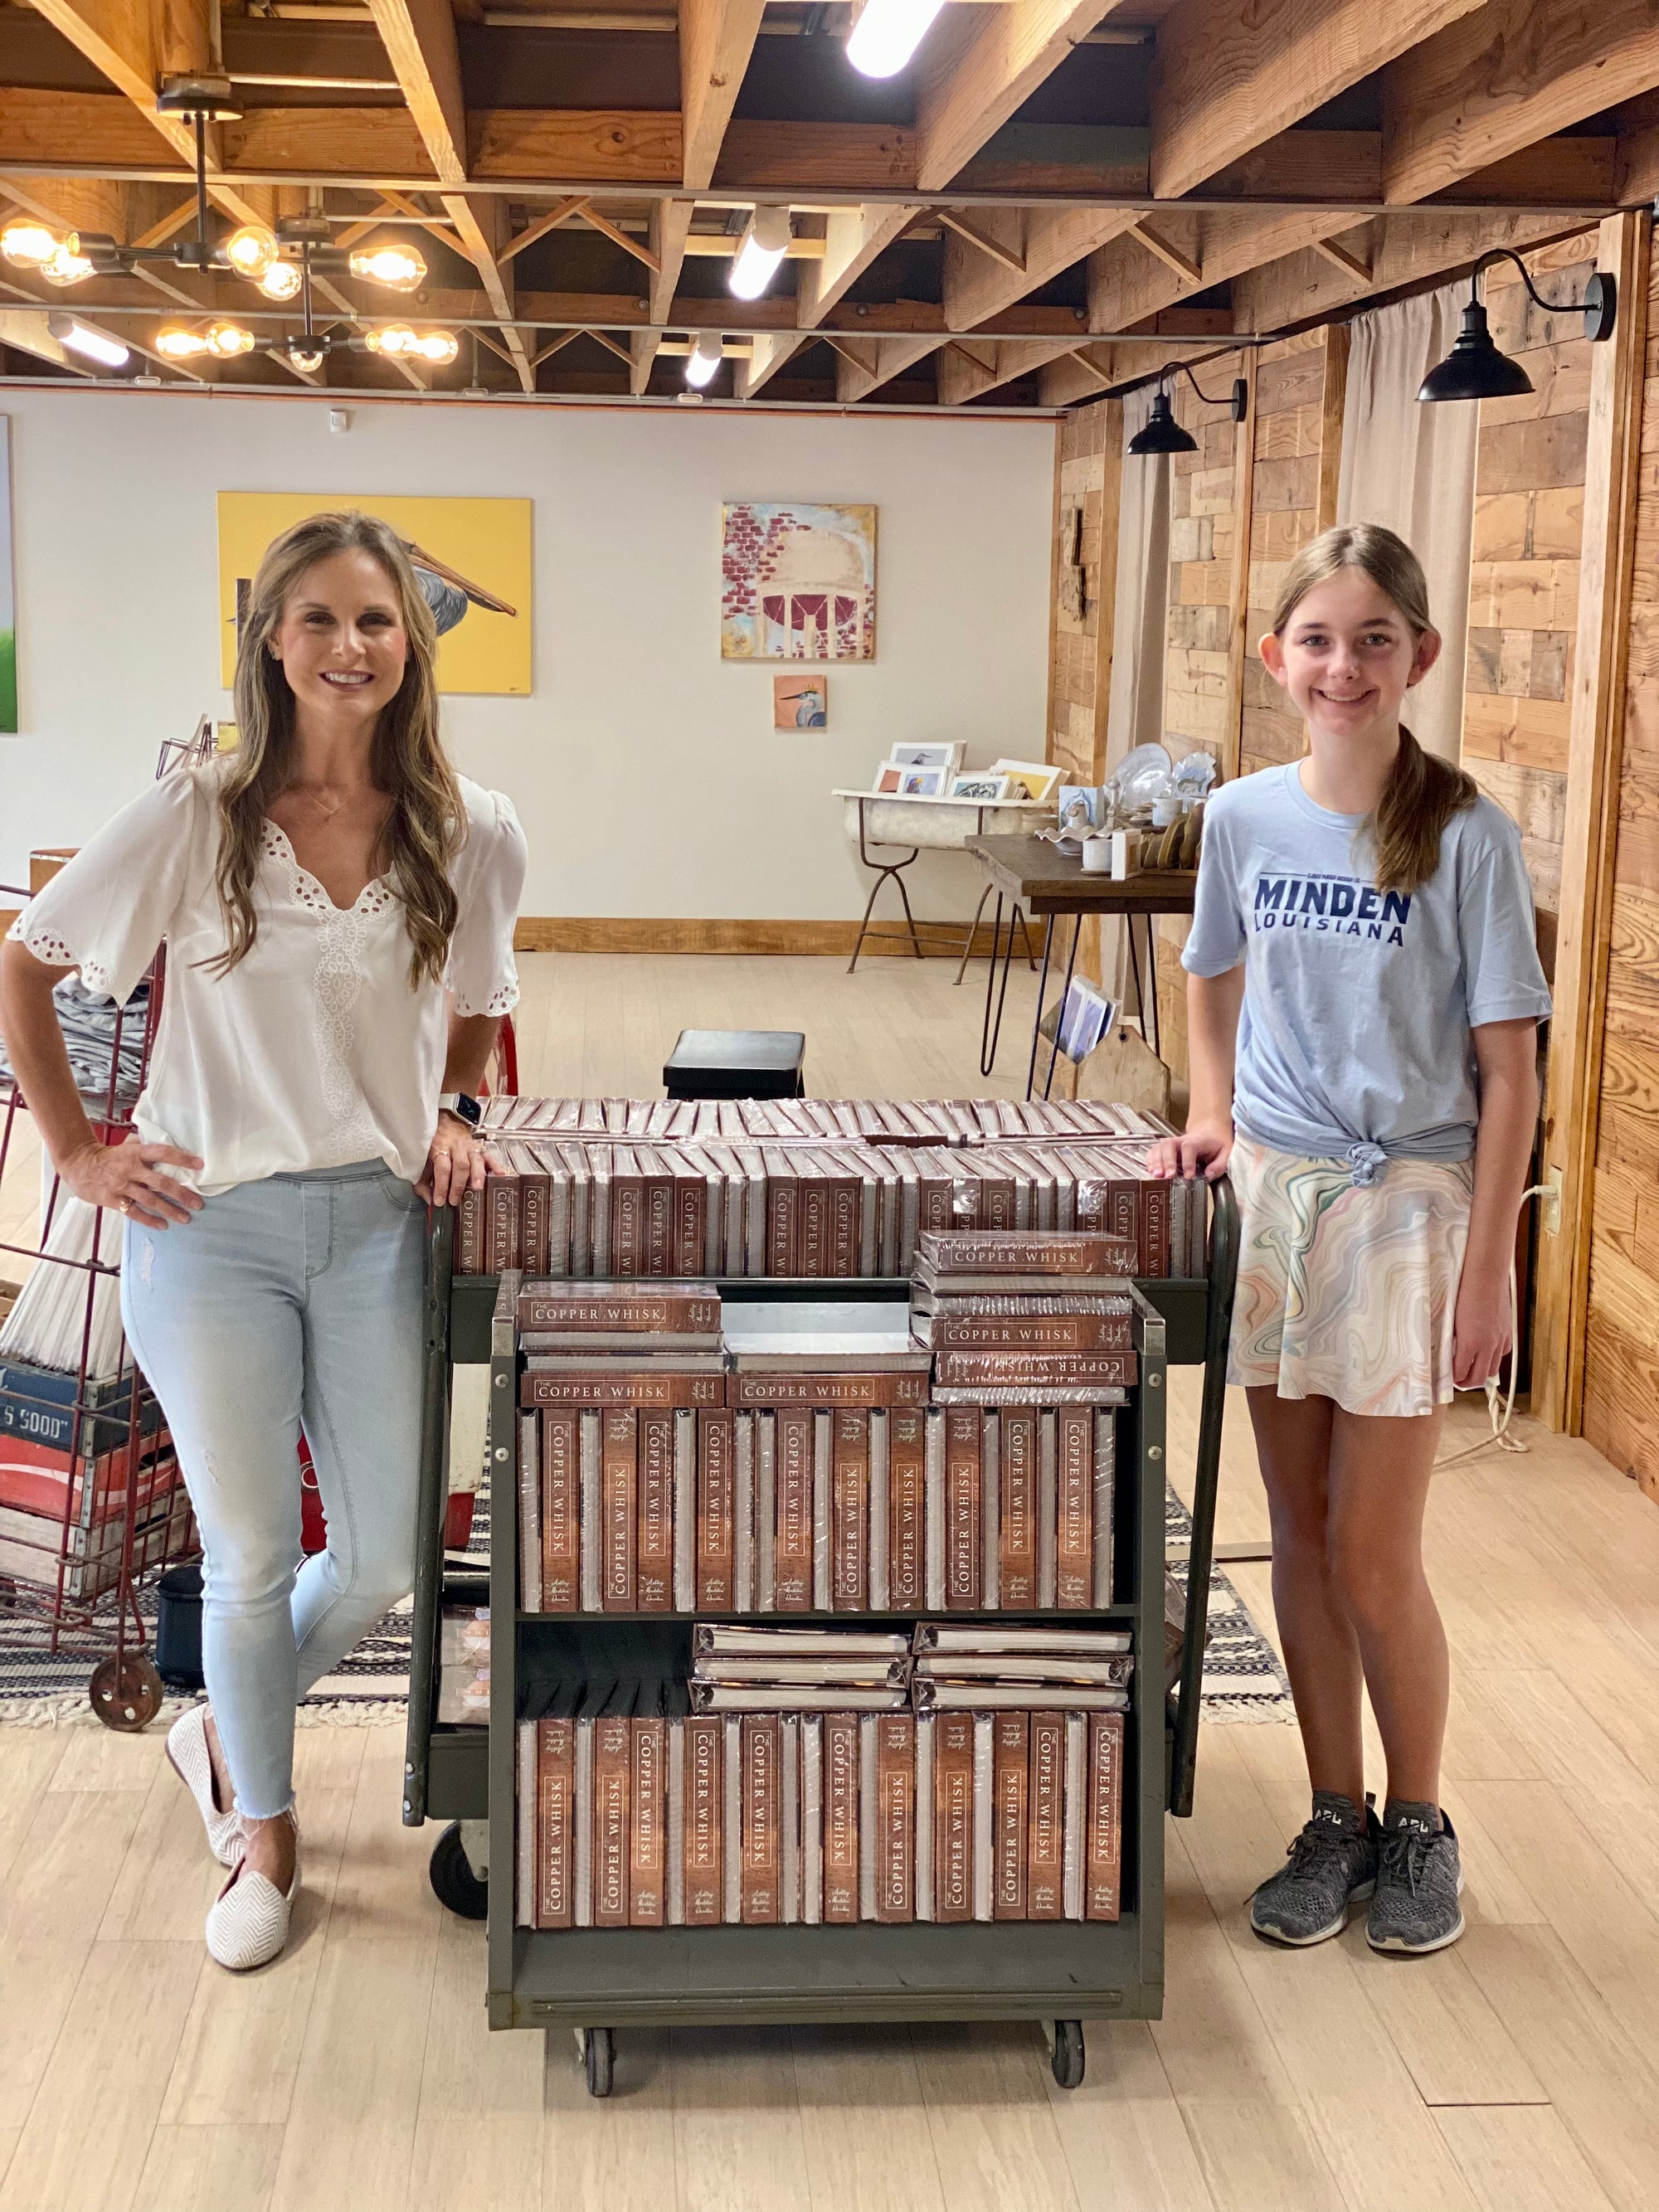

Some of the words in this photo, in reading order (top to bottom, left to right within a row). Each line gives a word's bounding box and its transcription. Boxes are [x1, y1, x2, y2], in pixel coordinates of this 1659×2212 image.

[1254, 879, 1411, 925] MINDEN
[1255, 913, 1404, 946] LOUISIANA
[464, 1190, 474, 1247] COPPER
[496, 1192, 507, 1249] COPPER
[527, 1189, 537, 1247] COPPER
[622, 1192, 632, 1248] COPPER
[653, 1190, 663, 1247] COPPER
[684, 1192, 694, 1249] COPPER
[776, 1193, 787, 1250] COPPER
[808, 1194, 818, 1251] COPPER
[838, 1193, 848, 1250] COPPER
[932, 1194, 941, 1237] COPP
[993, 1194, 1003, 1231] COPP
[1150, 1195, 1159, 1251] COPPER
[955, 1252, 1016, 1262] COPPER
[1026, 1252, 1078, 1262] WHISK
[535, 1309, 597, 1319] COPPER
[607, 1309, 661, 1319] WHISK
[949, 1330, 1010, 1339] COPPER
[1019, 1330, 1072, 1339] WHISK
[539, 1387, 601, 1397] COPPER
[611, 1387, 664, 1397] WHISK
[745, 1386, 806, 1396] COPPER
[816, 1386, 869, 1396] WHISK
[1060, 1361, 1119, 1371] COPPER
[553, 1426, 564, 1488] COPPER
[649, 1426, 659, 1488] COPPER
[709, 1427, 720, 1488] COPPER
[788, 1427, 799, 1488] COPPER
[1013, 1424, 1023, 1485] COPPER
[1069, 1425, 1079, 1486] COPPER
[615, 1468, 625, 1522] WHISK
[847, 1468, 857, 1521] WHISK
[903, 1469, 913, 1522] WHISK
[959, 1468, 969, 1520] WHISK
[1013, 1495, 1023, 1548] WHISK
[553, 1498, 564, 1551] WHISK
[649, 1498, 659, 1551] WHISK
[709, 1498, 719, 1551] WHISK
[788, 1498, 798, 1551] WHISK
[1069, 1496, 1079, 1548] WHISK
[615, 1532, 625, 1594] COPPER
[847, 1532, 857, 1593] COPPER
[903, 1532, 913, 1593] COPPER
[959, 1531, 969, 1592] COPPER
[641, 1735, 651, 1799] COPPER
[698, 1735, 708, 1797] COPPER
[755, 1735, 765, 1797] COPPER
[834, 1733, 844, 1796] COPPER
[1040, 1733, 1051, 1795] COPPER
[1099, 1732, 1111, 1794] COPPER
[551, 1782, 562, 1836] WHISK
[609, 1781, 620, 1835] WHISK
[893, 1777, 902, 1831] WHISK
[953, 1777, 963, 1831] WHISK
[1007, 1775, 1017, 1829] WHISK
[640, 1809, 651, 1864] WHISK
[698, 1808, 708, 1862] WHISK
[755, 1808, 765, 1862] WHISK
[834, 1806, 844, 1860] WHISK
[1039, 1805, 1050, 1859] WHISK
[1098, 1805, 1109, 1859] WHISK
[551, 1846, 562, 1910] COPPER
[608, 1845, 619, 1908] COPPER
[893, 1841, 902, 1904] COPPER
[952, 1841, 962, 1903] COPPER
[1006, 1839, 1017, 1901] COPPER
